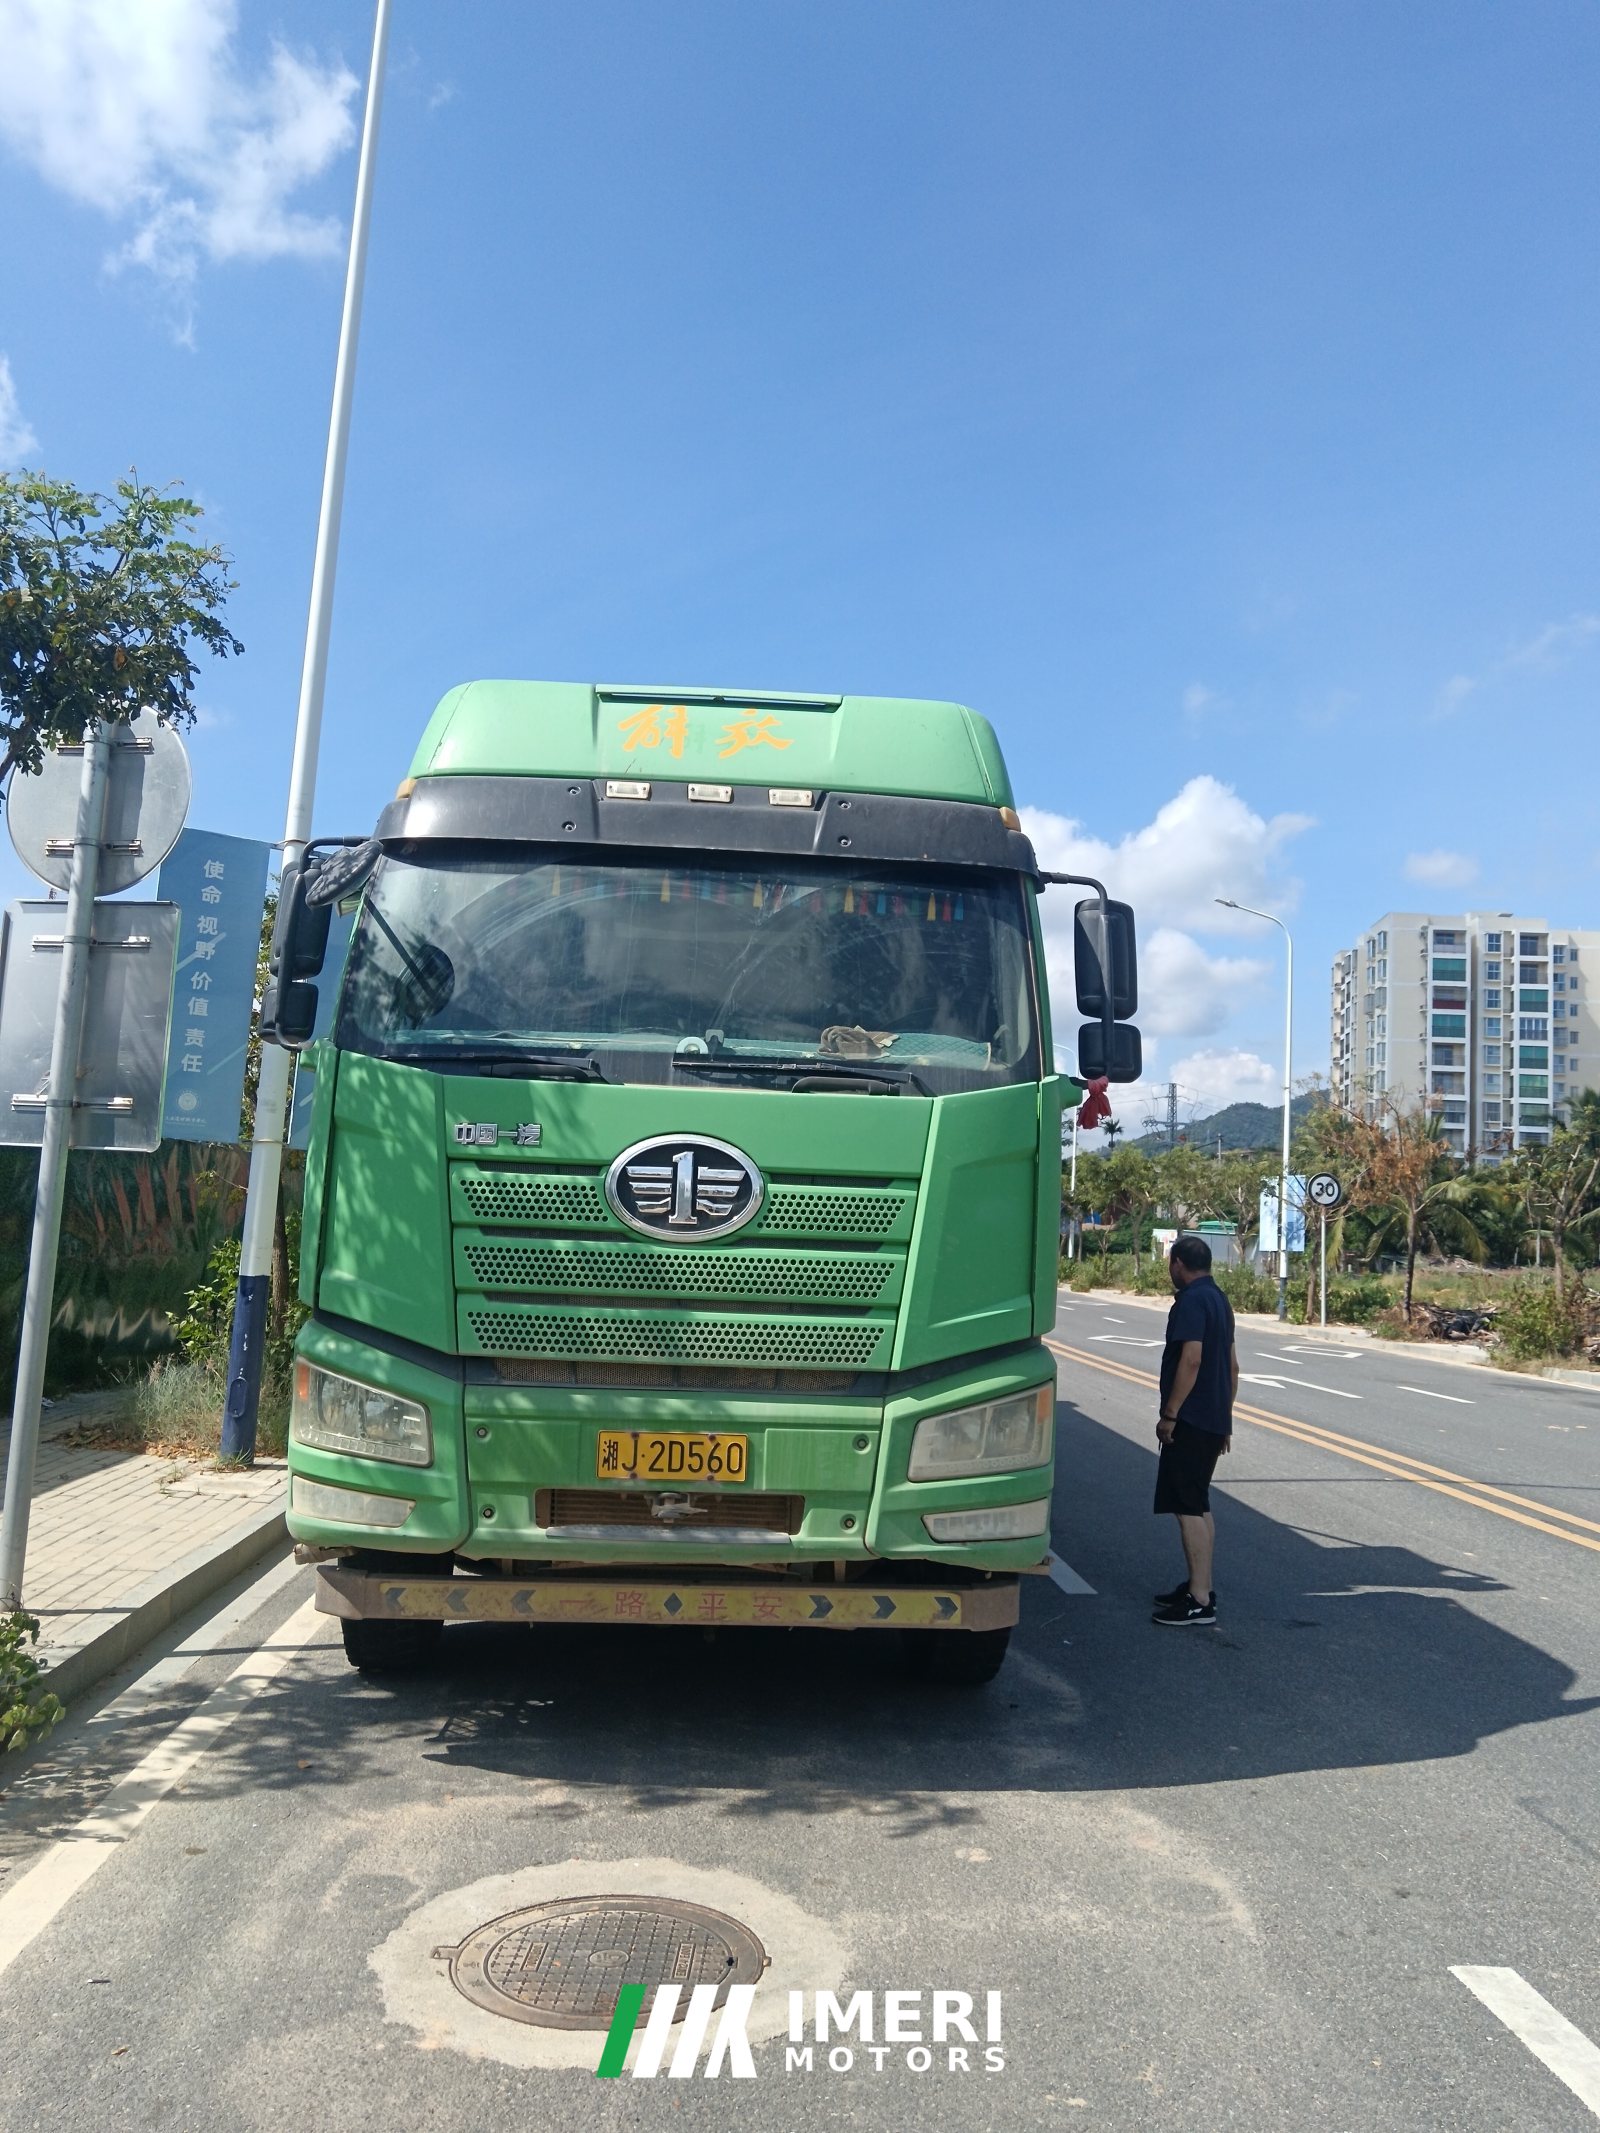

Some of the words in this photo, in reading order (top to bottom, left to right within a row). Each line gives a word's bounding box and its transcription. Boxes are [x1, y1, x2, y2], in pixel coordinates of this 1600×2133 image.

[455, 1123, 541, 1145] 中国一汽
[1315, 1182, 1335, 1197] 30
